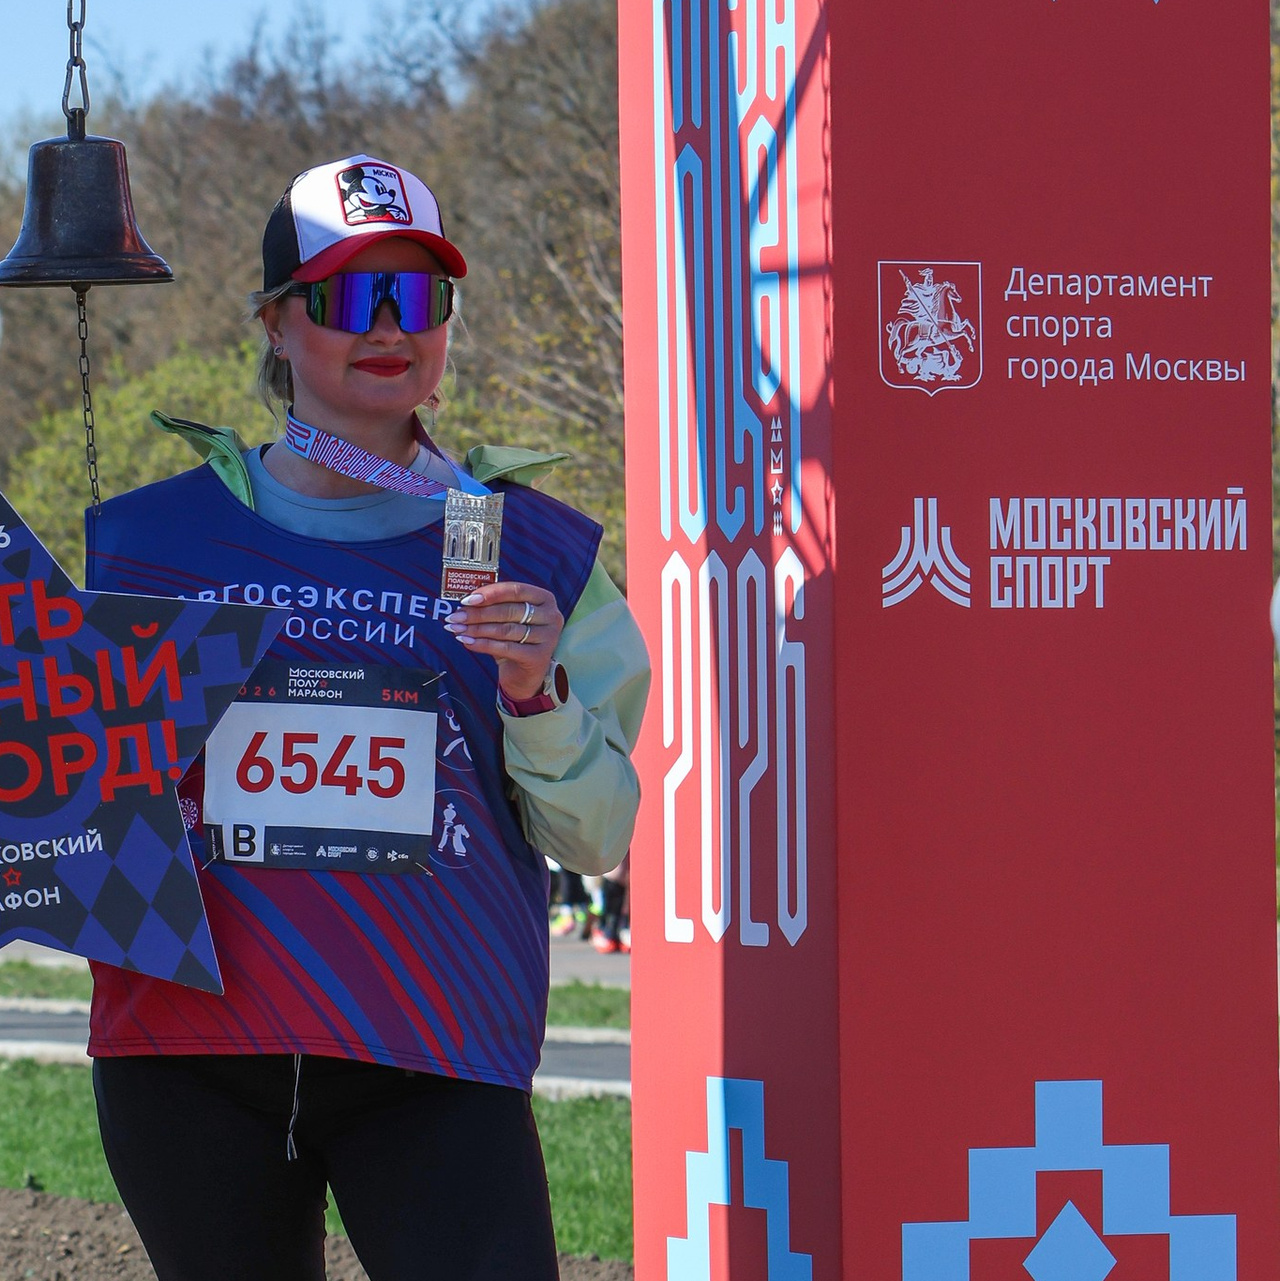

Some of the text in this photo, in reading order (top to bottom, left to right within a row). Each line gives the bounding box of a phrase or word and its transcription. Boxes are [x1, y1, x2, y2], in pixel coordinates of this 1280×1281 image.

[372, 168, 397, 180] MICKEY
[1004, 267, 1213, 304] Департамент
[1006, 315, 1112, 345] спорта
[1007, 352, 1246, 387] города Москвы
[989, 487, 1247, 551] МОСКОВСКИЙ
[448, 571, 491, 580] МОСКОВСКИЙ
[990, 556, 1111, 608] СПОРТ
[177, 583, 462, 621] ВГОСЭКСПЕР
[285, 616, 417, 649] ОССИИ
[288, 679, 319, 688] ПОЛУ
[289, 667, 365, 680] МОСКОВСКИЙ
[238, 685, 276, 697] 026
[288, 688, 343, 699] МАРАФОН
[661, 547, 807, 947] 2026
[235, 731, 406, 799] 6545
